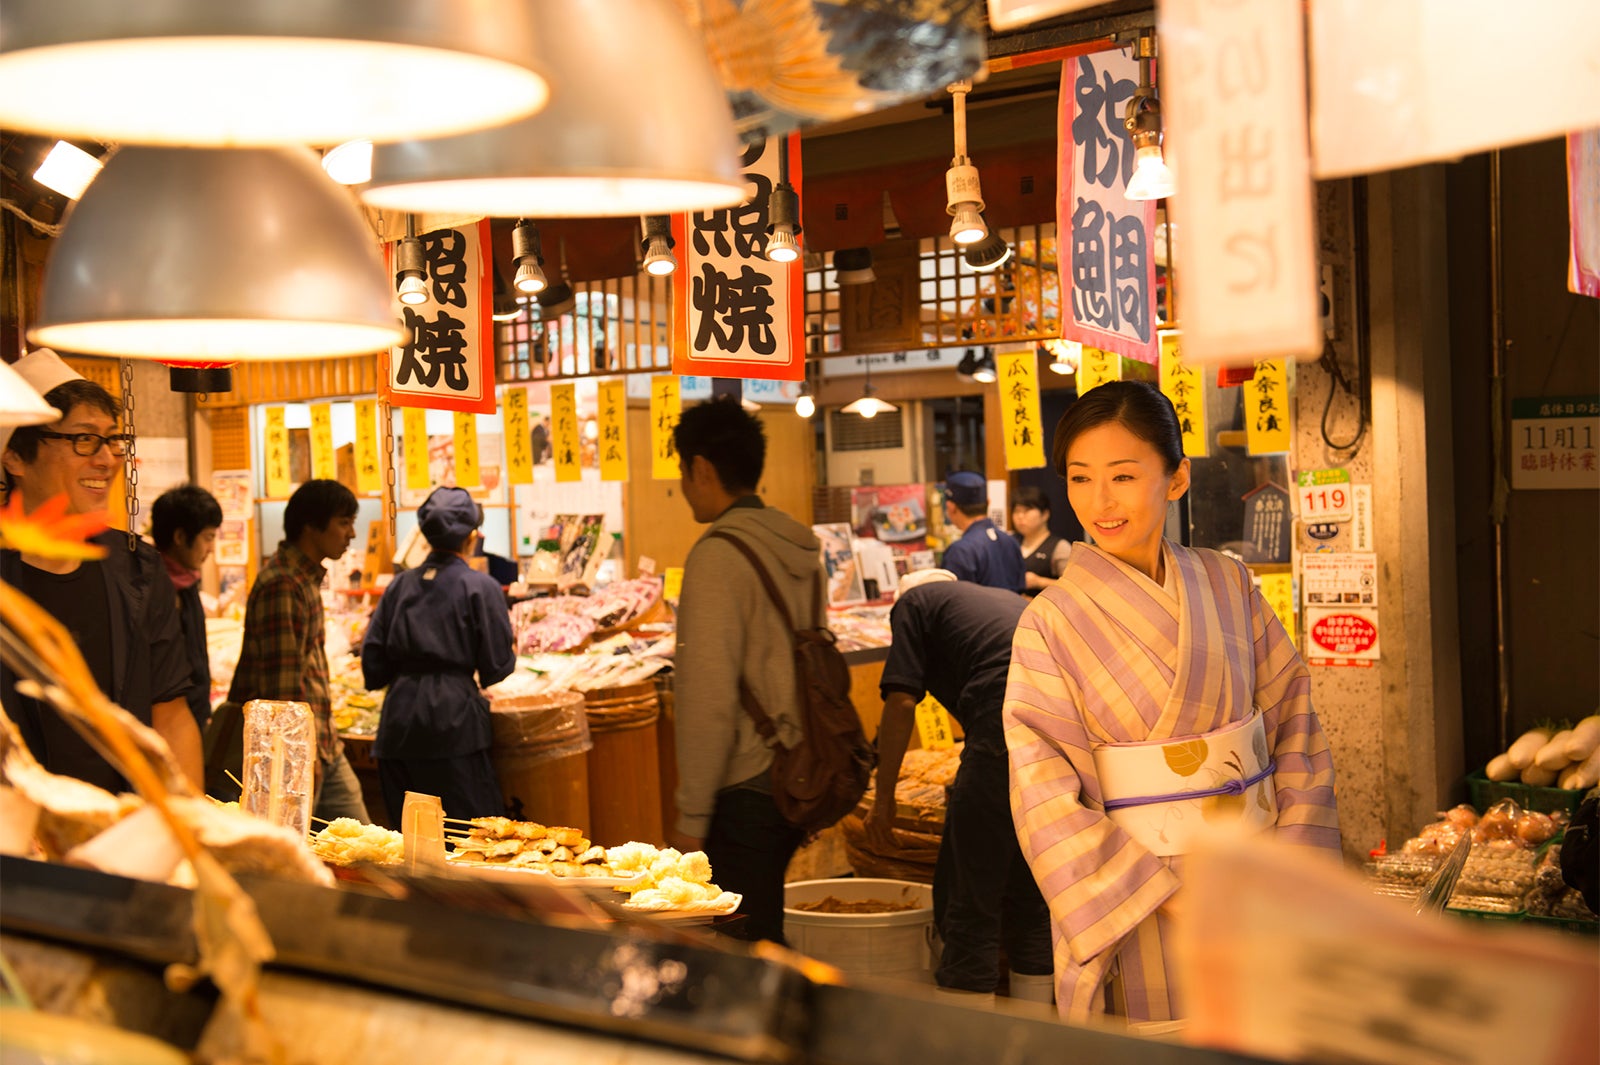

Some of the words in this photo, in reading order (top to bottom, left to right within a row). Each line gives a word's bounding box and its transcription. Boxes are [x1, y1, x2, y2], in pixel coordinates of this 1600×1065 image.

[693, 137, 777, 355] 照焼
[1008, 358, 1034, 447] 瓜奈良漬
[1255, 359, 1282, 432] 瓜奈良漬
[1520, 451, 1597, 473] 臨時休業
[1305, 489, 1345, 511] 119
